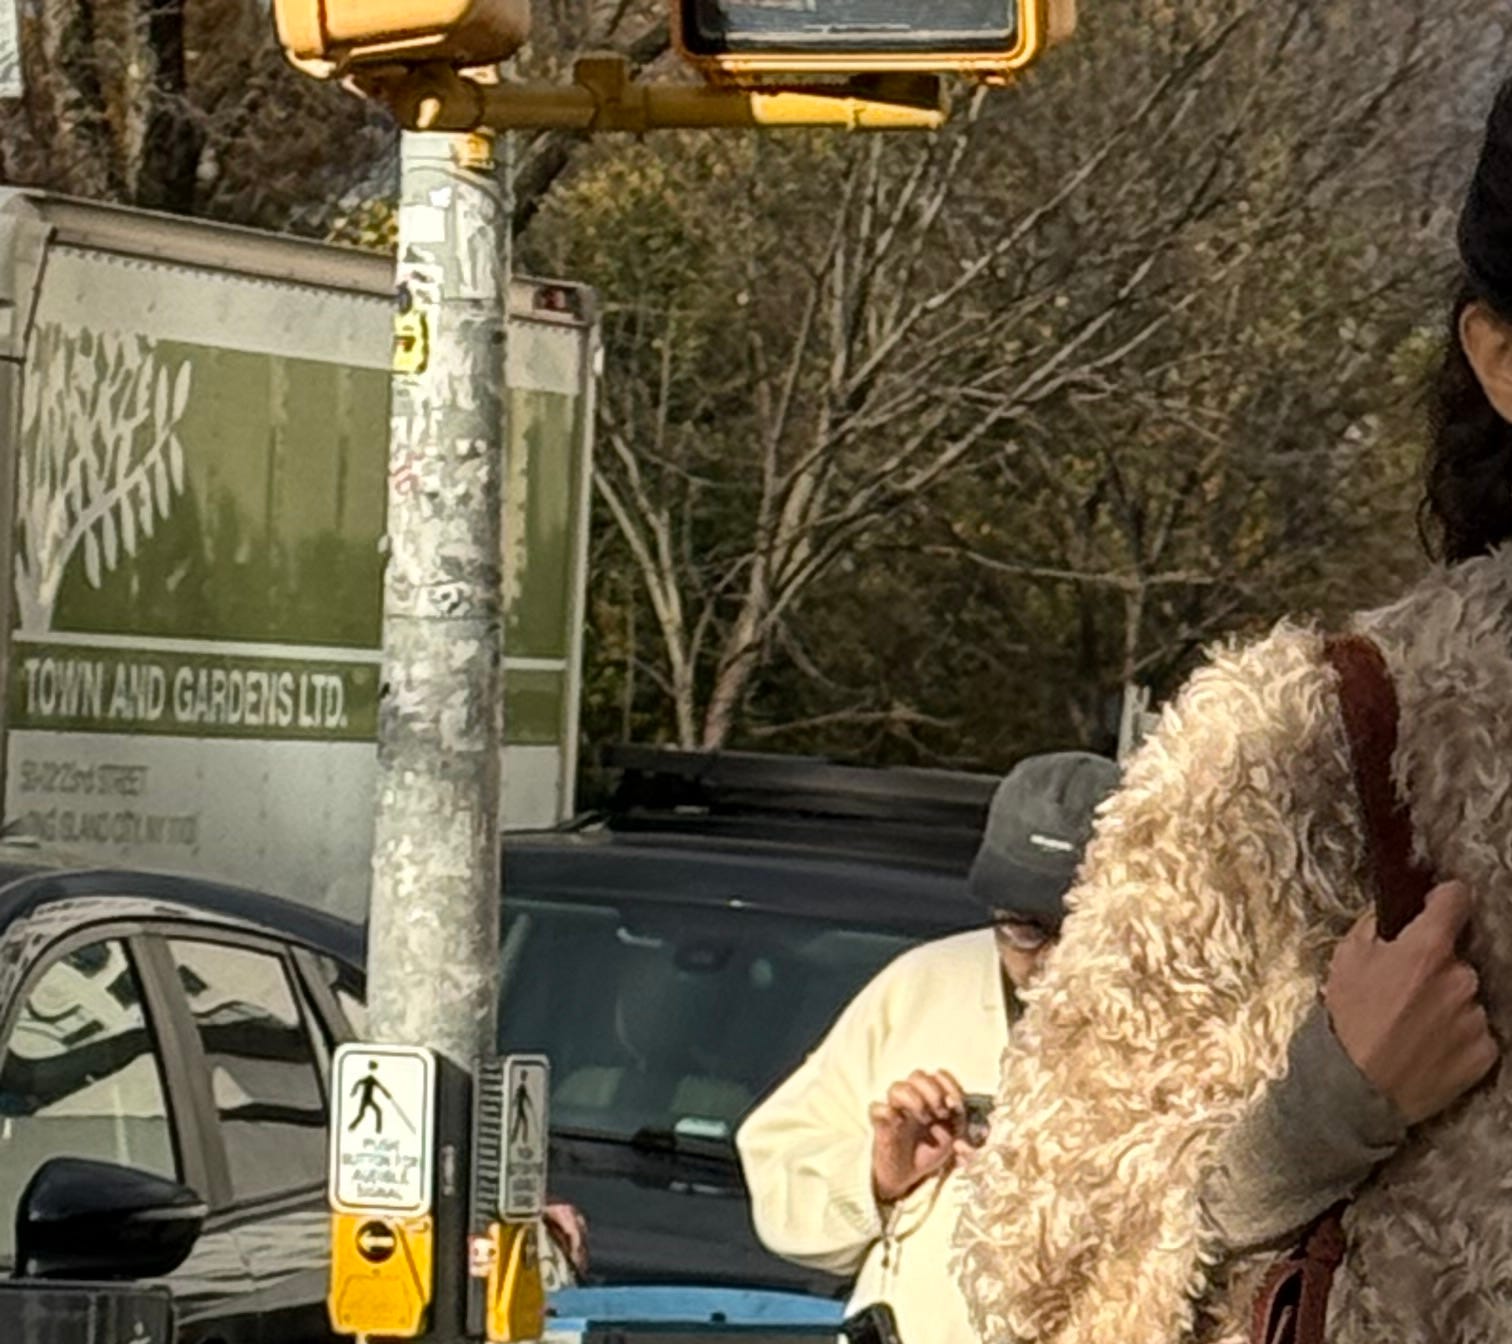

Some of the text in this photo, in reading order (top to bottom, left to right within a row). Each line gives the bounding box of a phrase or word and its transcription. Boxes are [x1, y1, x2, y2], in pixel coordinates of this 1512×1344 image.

[24, 658, 348, 727] TOWN AND GARDENS LTD.
